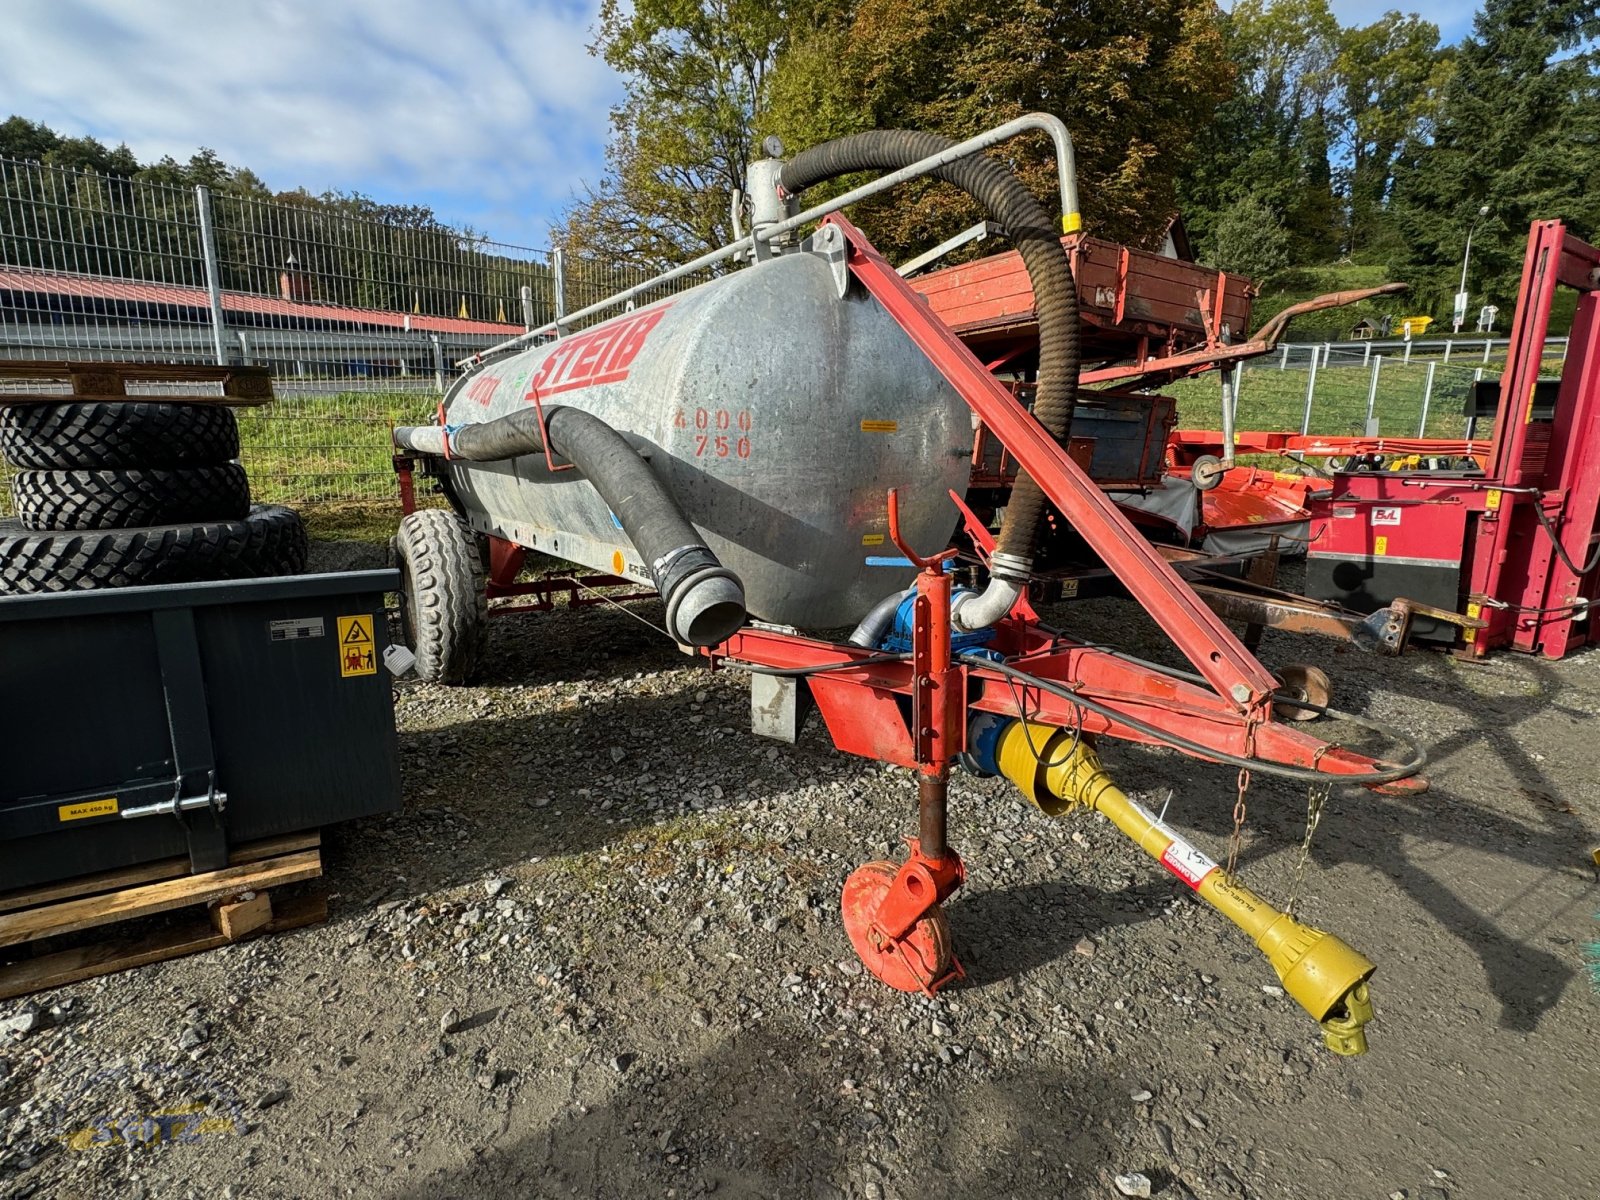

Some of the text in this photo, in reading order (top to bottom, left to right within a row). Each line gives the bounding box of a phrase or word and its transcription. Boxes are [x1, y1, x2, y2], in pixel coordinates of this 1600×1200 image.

[674, 406, 751, 430] 4000
[695, 435, 751, 458] 750
[1164, 854, 1192, 879] DANGER
[1217, 881, 1257, 914] BLUELINE
